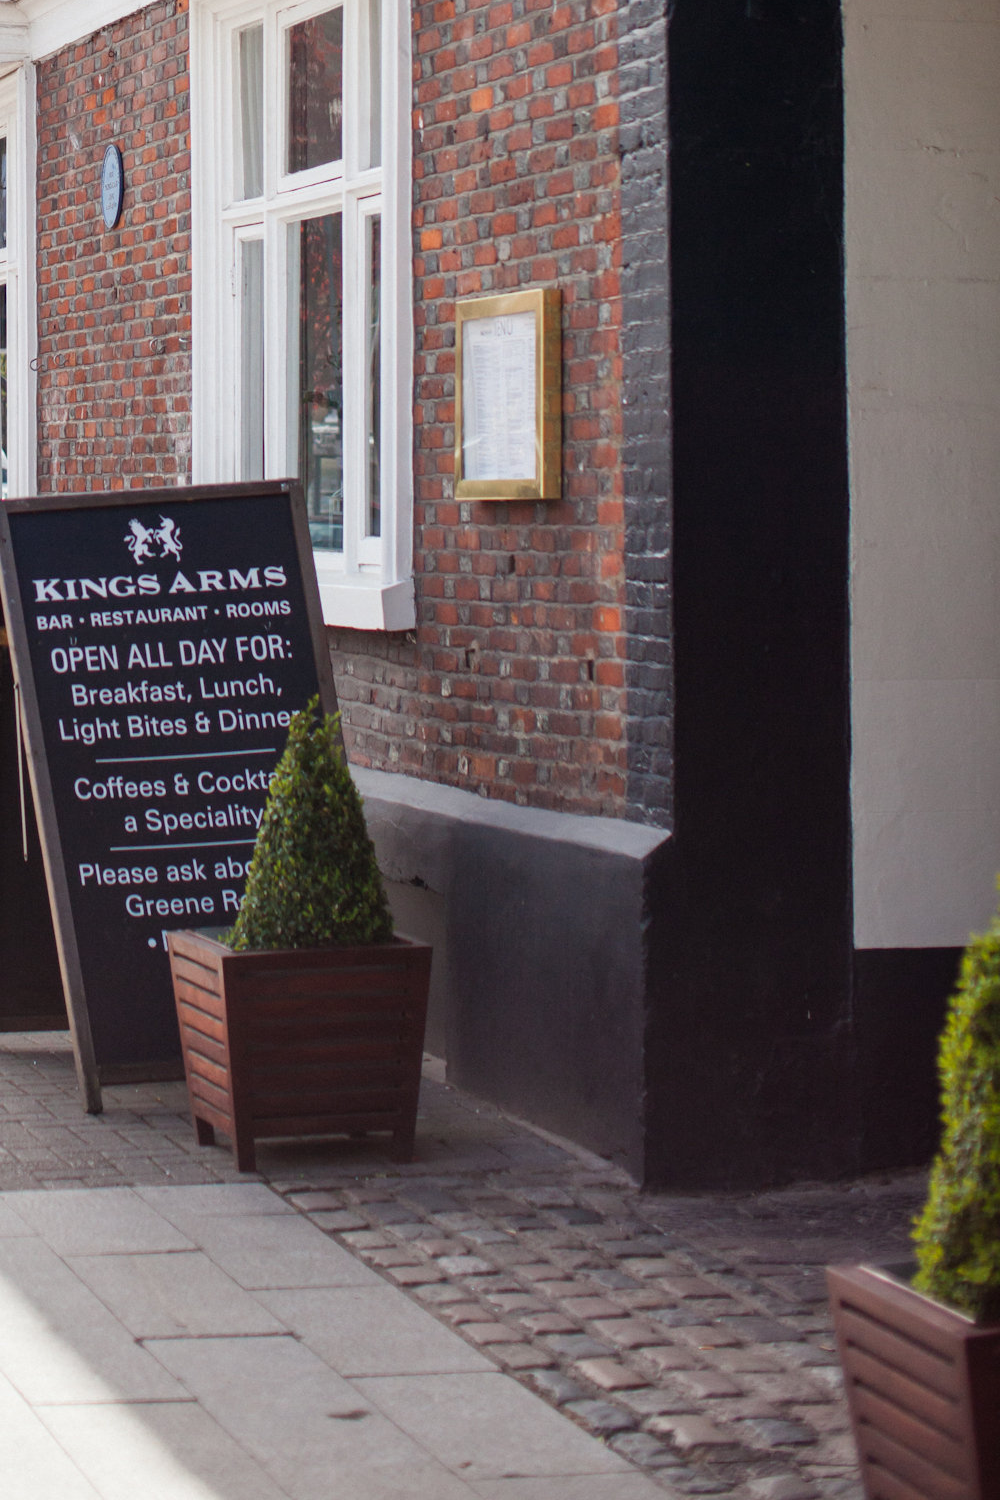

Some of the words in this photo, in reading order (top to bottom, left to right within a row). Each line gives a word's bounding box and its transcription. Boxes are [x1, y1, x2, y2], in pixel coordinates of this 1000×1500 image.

[32, 573, 161, 603] KINGS
[169, 566, 287, 594] ARMS
[36, 614, 73, 630] BAR
[91, 605, 208, 627] RESTAURANT
[227, 600, 291, 618] ROOMS
[51, 644, 119, 673] OPEN
[128, 642, 173, 669] ALL
[179, 637, 227, 666] DAY
[236, 634, 293, 662] FOR:
[71, 681, 192, 707] Breakfast,
[199, 673, 282, 700] Lunch,
[59, 717, 121, 745] Light
[127, 713, 188, 738] Bites
[195, 711, 211, 734] &
[74, 776, 166, 800] Coffees
[174, 773, 189, 795] &
[197, 768, 278, 794] Cockta
[124, 815, 138, 832] a
[145, 804, 264, 835] Speciality
[78, 863, 158, 886] Please
[166, 859, 207, 882] ask
[125, 893, 215, 917] Greene
